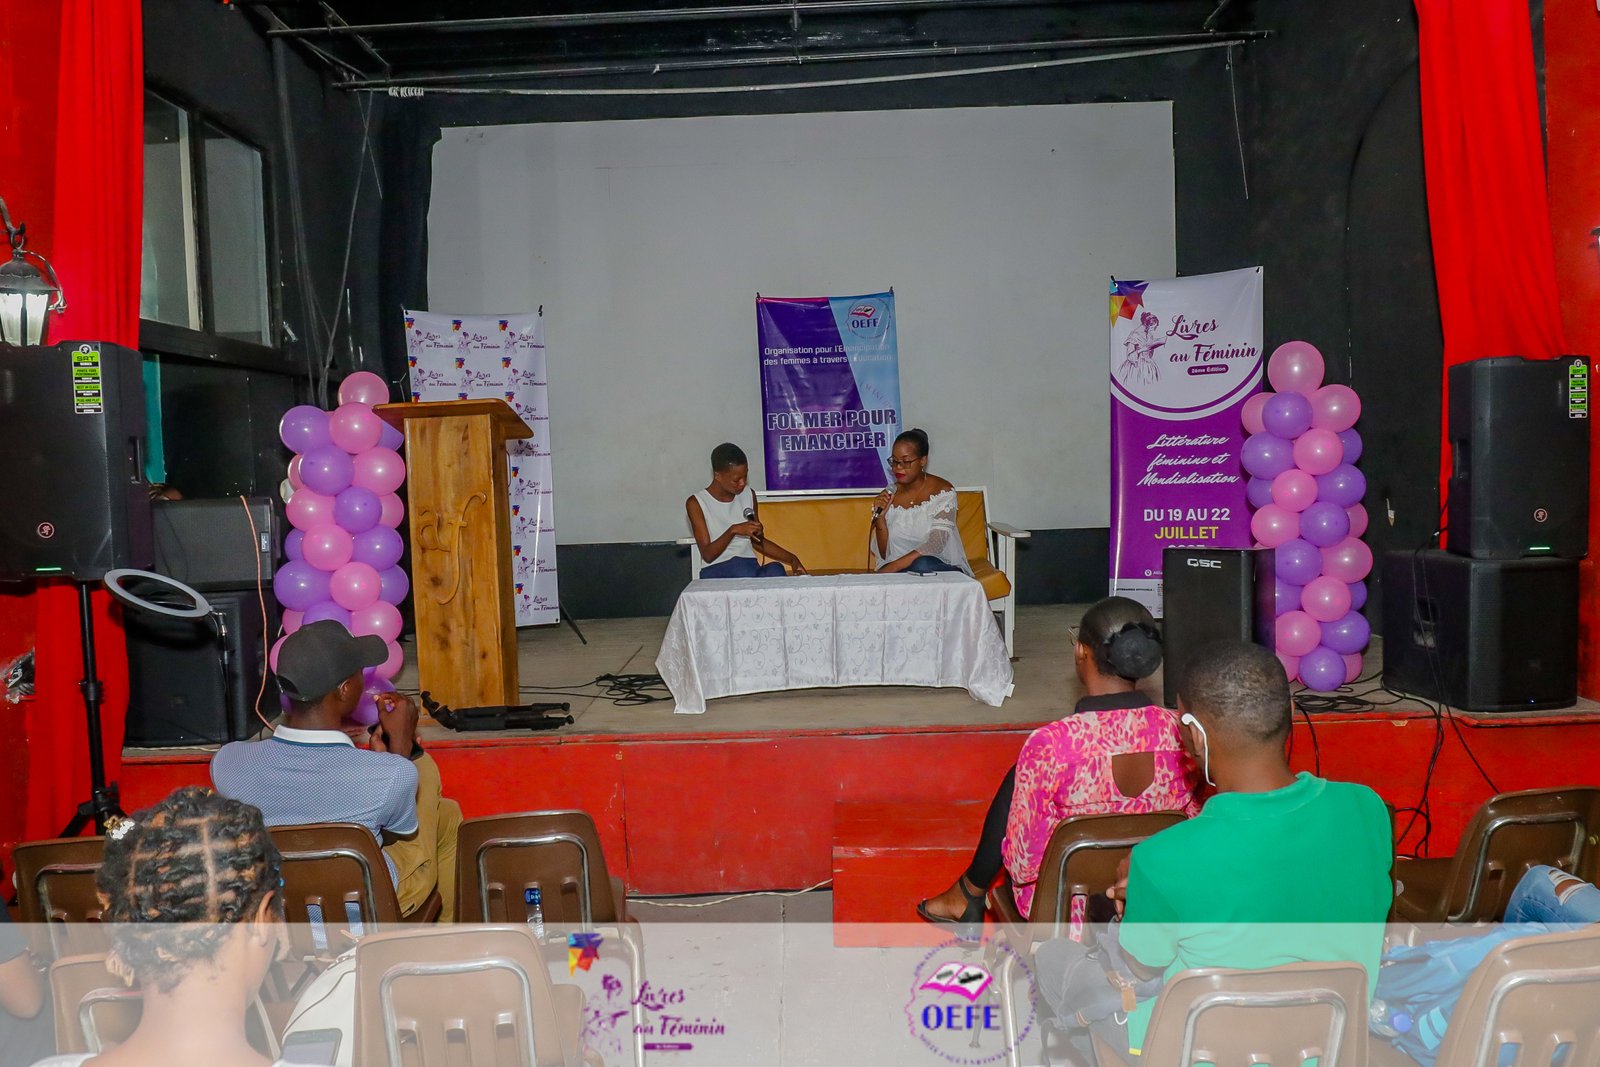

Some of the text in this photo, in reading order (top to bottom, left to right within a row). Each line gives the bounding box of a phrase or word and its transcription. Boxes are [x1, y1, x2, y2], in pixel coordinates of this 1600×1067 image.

[1166, 314, 1219, 341] Livres
[764, 346, 814, 357] Organisation
[815, 346, 833, 355] pour
[1169, 342, 1259, 363] au Féminin
[763, 357, 778, 366] des
[780, 357, 811, 365] femmes
[812, 356, 818, 364] à
[820, 356, 848, 364] travers
[846, 409, 897, 428] POUR
[780, 431, 886, 452] EMANCIPER
[1146, 434, 1230, 450] Littérature
[1146, 452, 1231, 472] féminine et
[1136, 472, 1240, 487] Mondialisation
[1143, 507, 1230, 522] DU 19 AU 22
[1154, 526, 1219, 540] JUILLET
[1186, 557, 1222, 569] QSC
